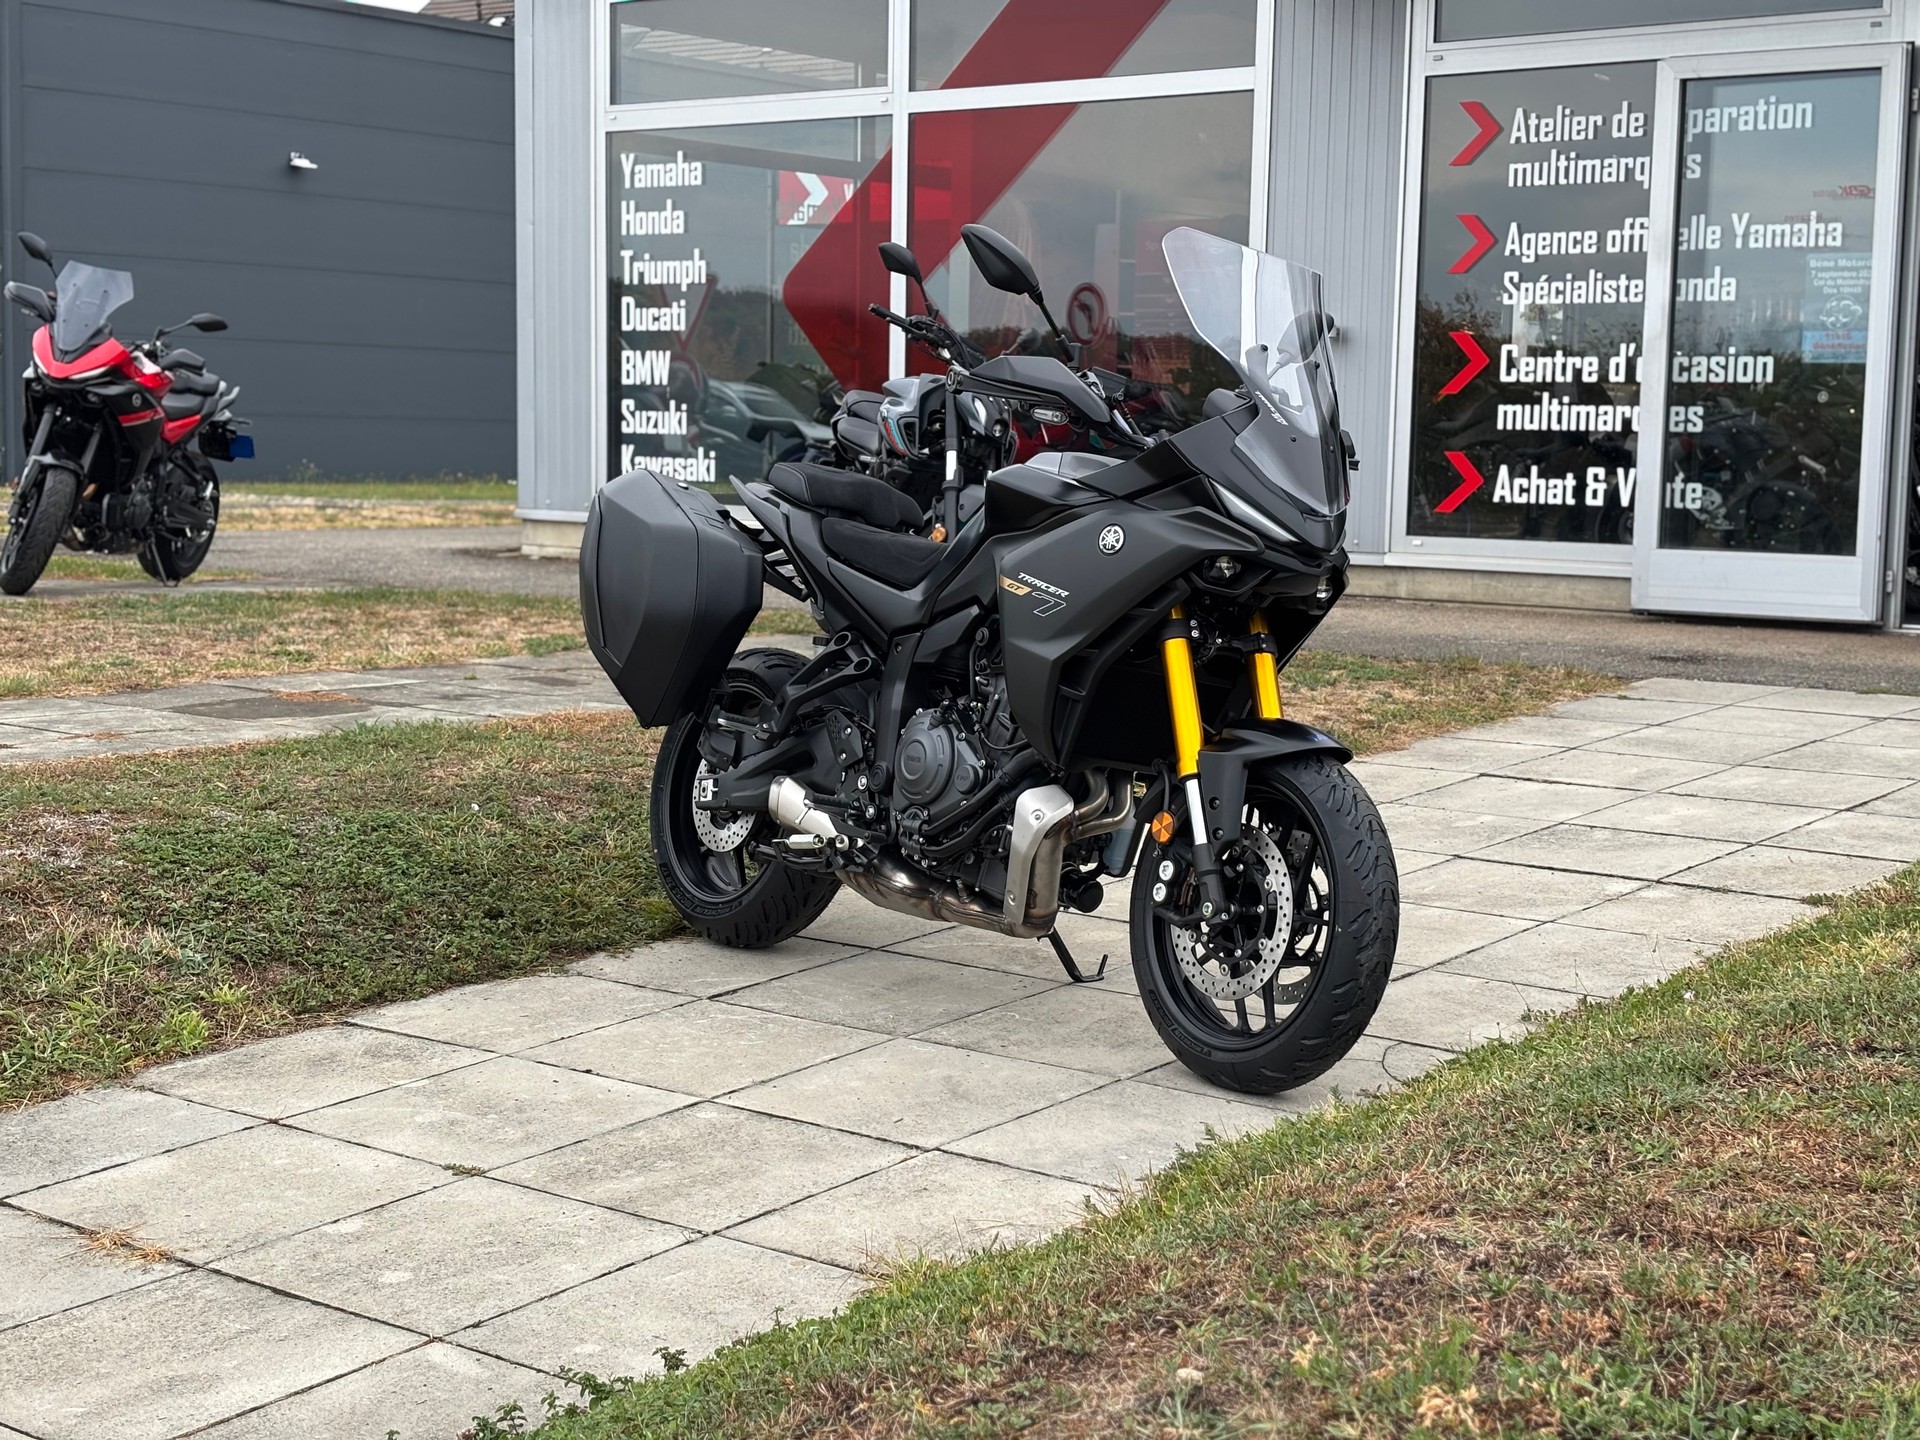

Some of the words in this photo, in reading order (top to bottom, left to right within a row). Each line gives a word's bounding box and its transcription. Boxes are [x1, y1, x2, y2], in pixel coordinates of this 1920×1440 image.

[1509, 105, 1603, 144] Atelier
[1612, 101, 1645, 138] de
[620, 151, 702, 189] Yamaha
[620, 199, 685, 236] Honda
[1504, 222, 1598, 263] Agence
[1731, 210, 1843, 249] Yamaha
[620, 248, 707, 292] Triumph
[1503, 269, 1644, 312] Spécialiste
[620, 297, 686, 332] Ducati
[620, 350, 672, 386] BMW
[1500, 344, 1599, 383] Centre
[620, 398, 688, 436] Suzuki
[621, 443, 716, 482] Kawasaki
[1492, 464, 1577, 506] Achat
[1585, 466, 1607, 507] &
[1006, 582, 1025, 592] GT
[1032, 591, 1066, 617] 7
[1018, 572, 1070, 598] TRACER
